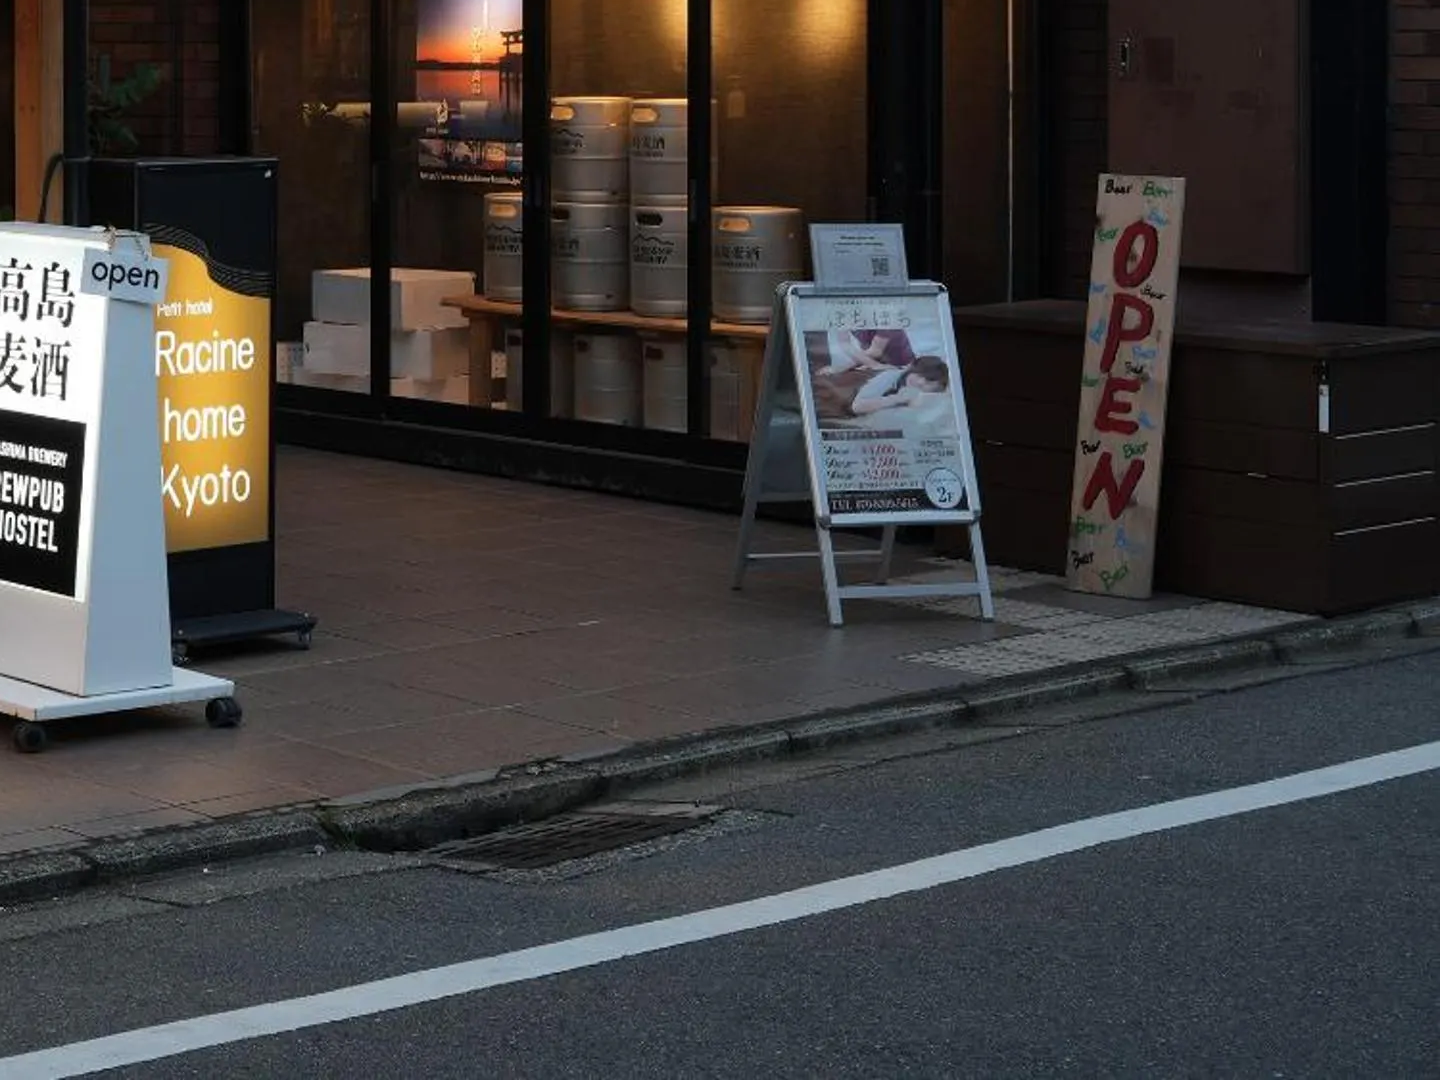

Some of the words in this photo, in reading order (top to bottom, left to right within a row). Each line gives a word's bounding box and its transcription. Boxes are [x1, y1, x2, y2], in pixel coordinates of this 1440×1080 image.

[91, 261, 160, 291] open
[155, 330, 255, 377] Racine
[1082, 220, 1158, 520] OPEN
[164, 397, 246, 443] home
[161, 463, 251, 517] Kyoto
